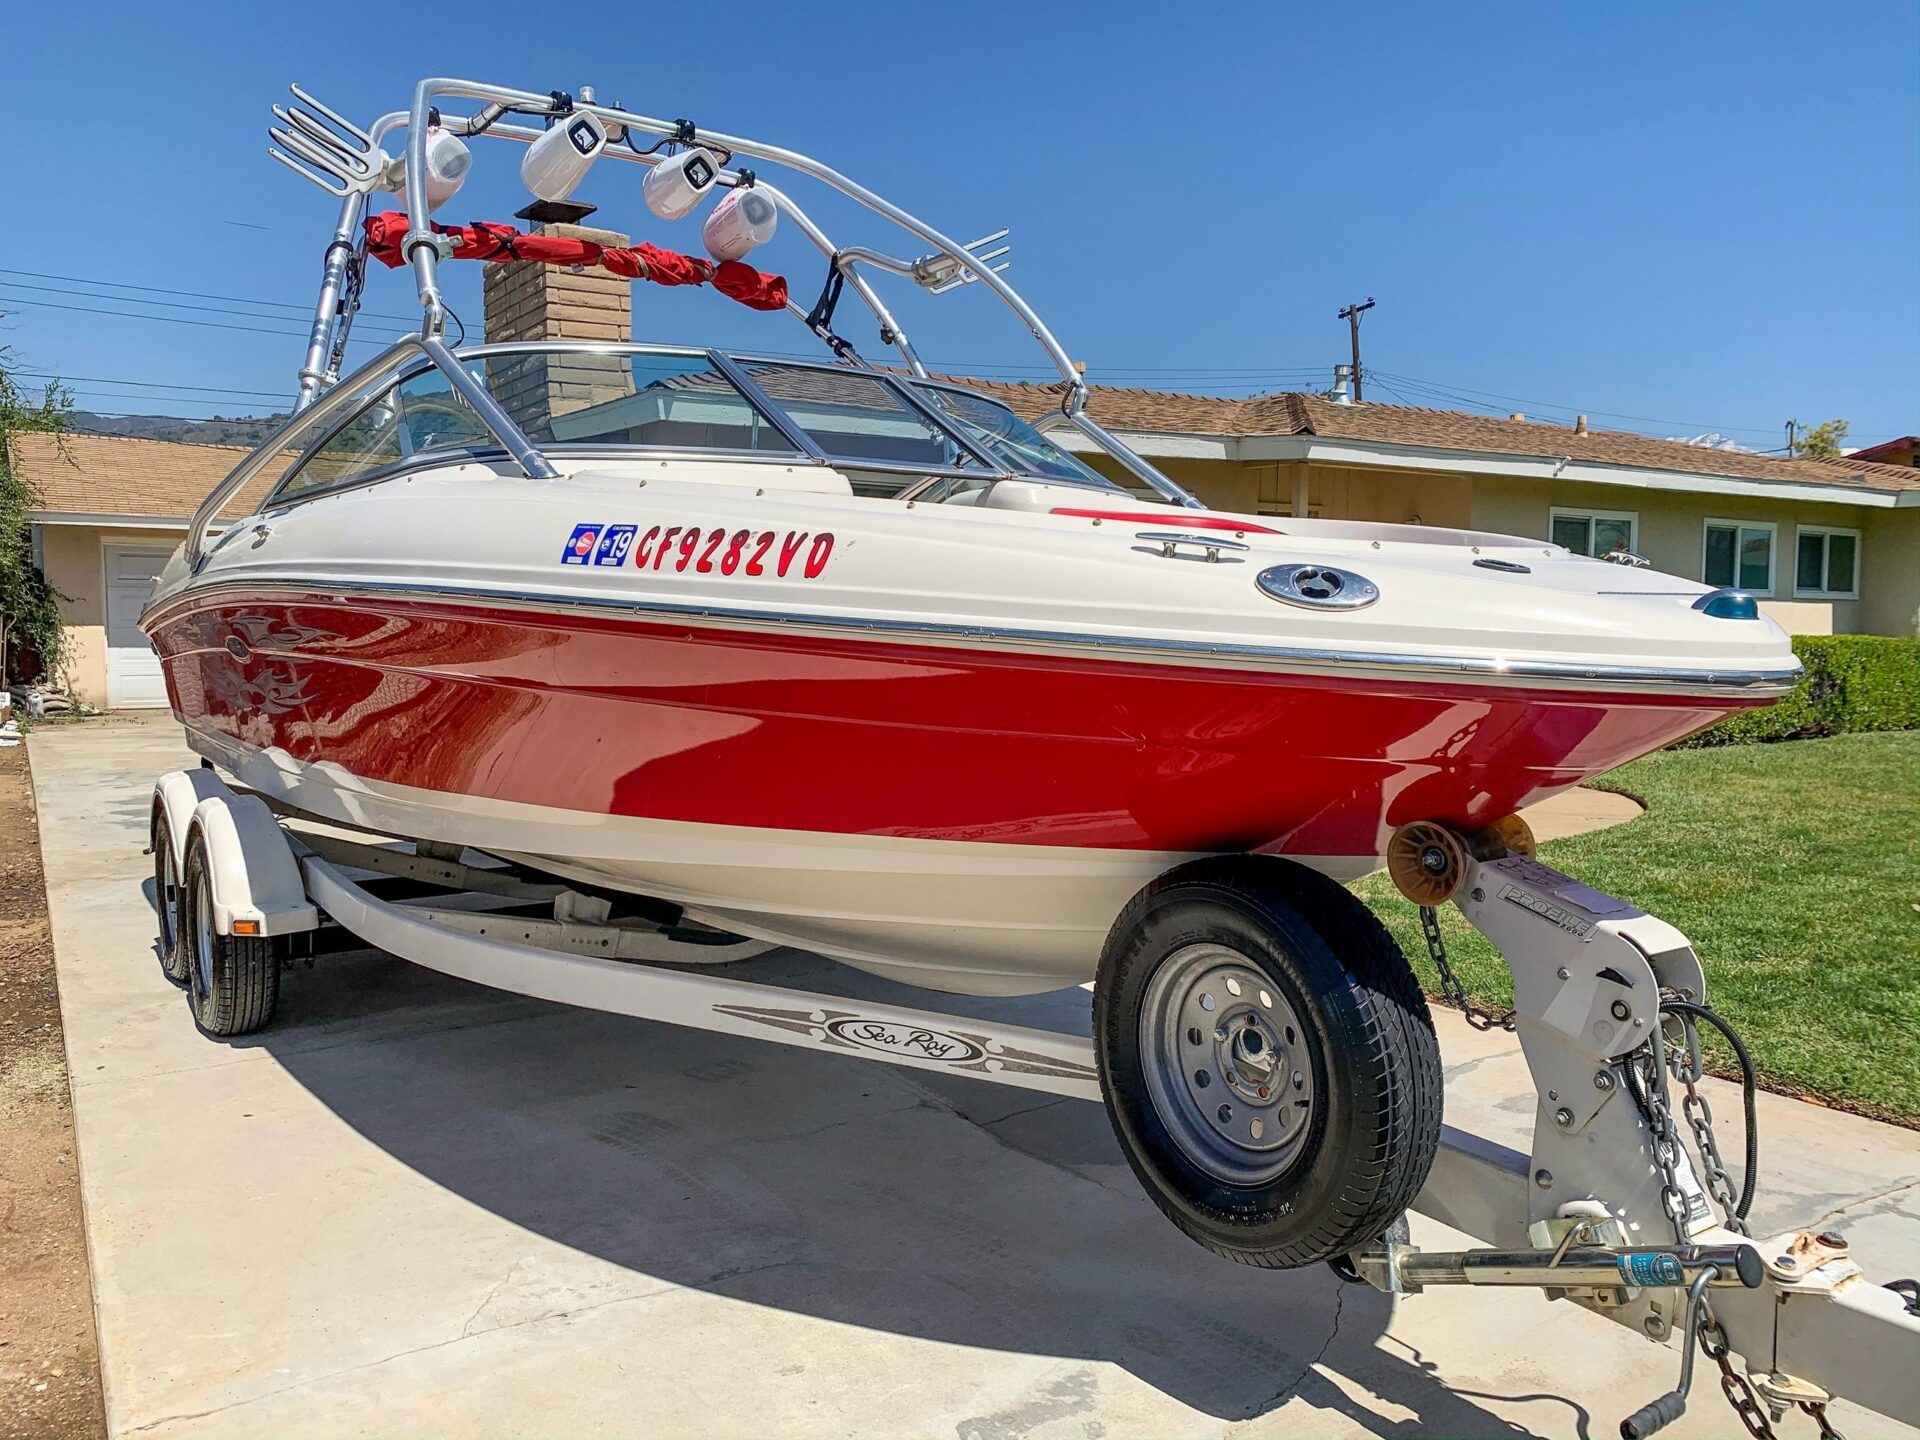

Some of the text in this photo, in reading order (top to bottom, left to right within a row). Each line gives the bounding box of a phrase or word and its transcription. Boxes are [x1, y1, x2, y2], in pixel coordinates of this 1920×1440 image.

[609, 531, 633, 558] 19
[635, 525, 835, 579] CF9282VD
[1507, 887, 1592, 934] PROFILE
[1559, 923, 1584, 937] 2000
[853, 1024, 956, 1058] Sea Ray
